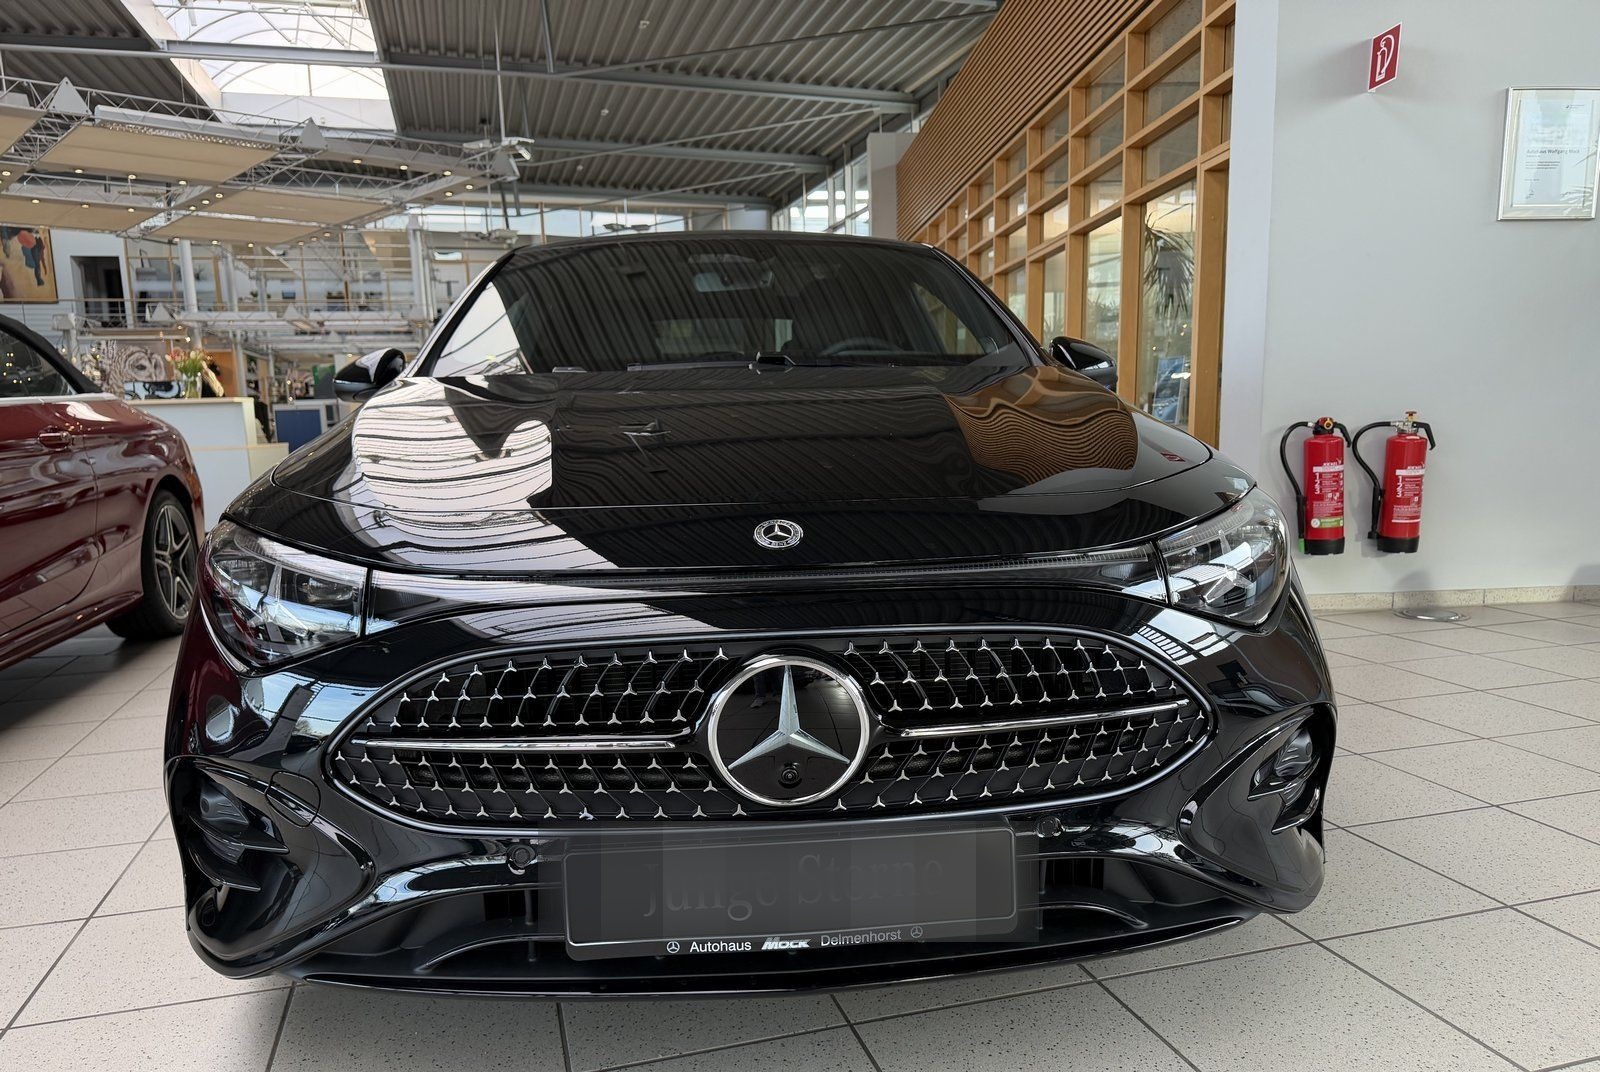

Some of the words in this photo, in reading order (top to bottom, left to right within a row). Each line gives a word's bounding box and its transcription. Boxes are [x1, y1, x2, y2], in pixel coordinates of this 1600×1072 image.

[643, 863, 778, 922] Junge
[797, 853, 944, 905] Sterne
[689, 940, 752, 953] Autohaus
[820, 929, 902, 947] Delmenhorst
